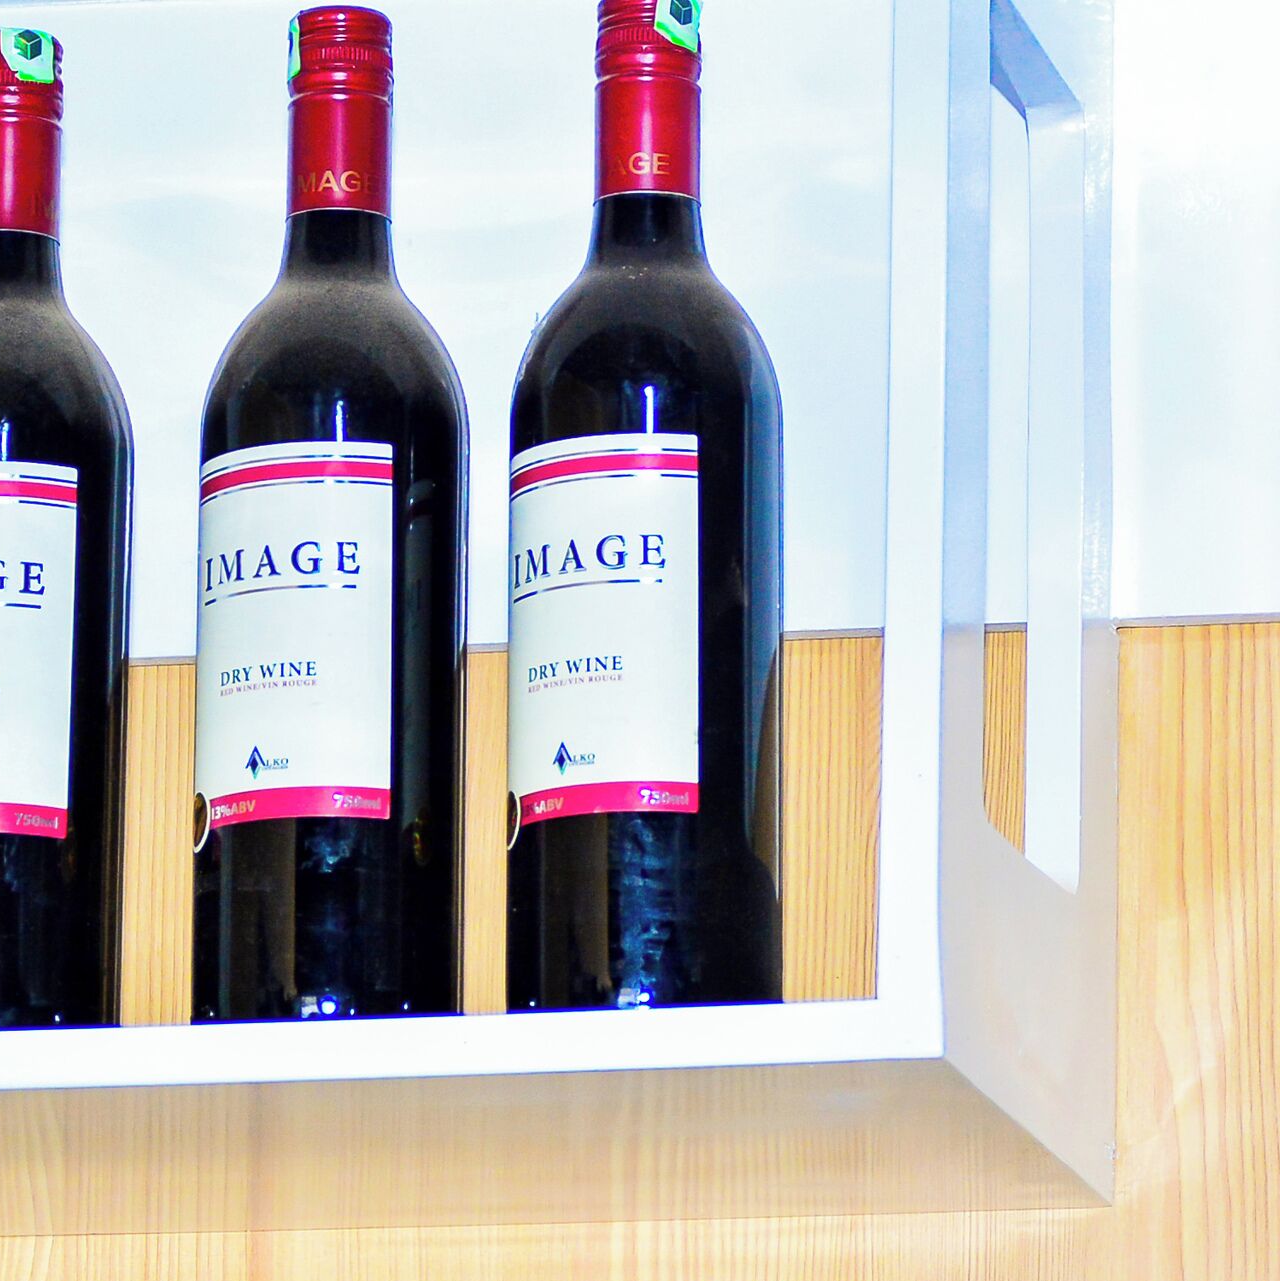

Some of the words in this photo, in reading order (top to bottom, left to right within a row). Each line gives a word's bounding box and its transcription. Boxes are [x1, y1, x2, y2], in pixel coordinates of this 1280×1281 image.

[205, 541, 361, 592] IMAGE
[514, 533, 666, 590] IMAGE
[220, 667, 252, 687] DRY
[259, 661, 317, 680] WINE
[528, 662, 559, 683] DRY
[565, 655, 623, 674] WINE
